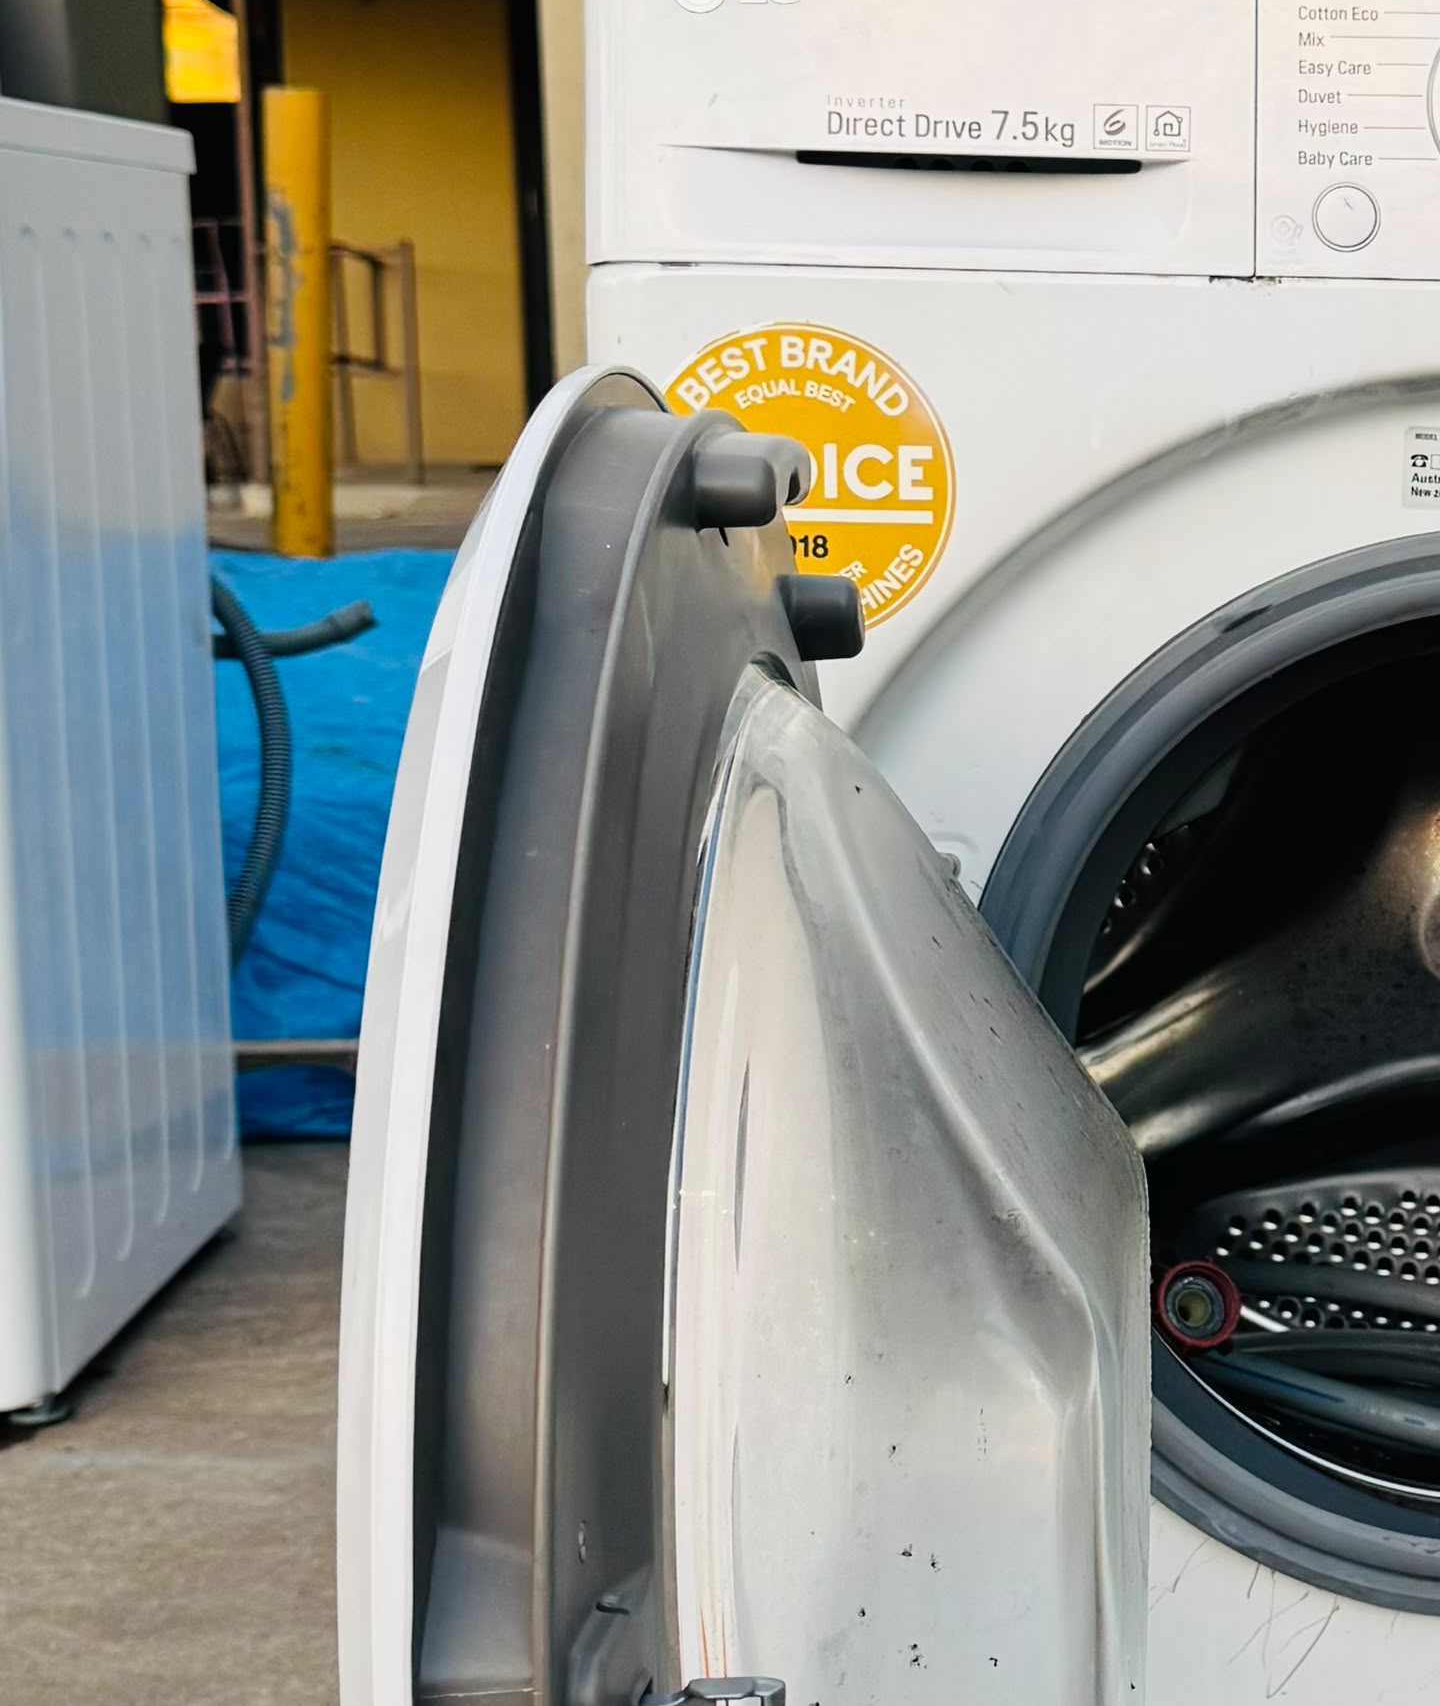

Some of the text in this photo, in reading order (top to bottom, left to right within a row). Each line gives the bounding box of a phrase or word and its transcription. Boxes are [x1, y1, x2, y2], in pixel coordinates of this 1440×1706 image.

[1298, 5, 1378, 21] Cotton Eco
[1298, 32, 1325, 47] Mix
[1298, 59, 1371, 77] Easy Care
[827, 94, 906, 109] Inverter
[1298, 89, 1342, 104] Duvet
[826, 110, 1075, 148] Direct Drive 7.5kg
[1298, 119, 1358, 137] Hygiene
[1298, 150, 1373, 169] Baby Care
[676, 334, 909, 417] BEST BRAND
[734, 378, 856, 413] EQUAL BEST
[808, 443, 934, 501] ICE
[1411, 486, 1431, 497] New
[790, 534, 829, 559] 18
[860, 543, 925, 615] HINES
